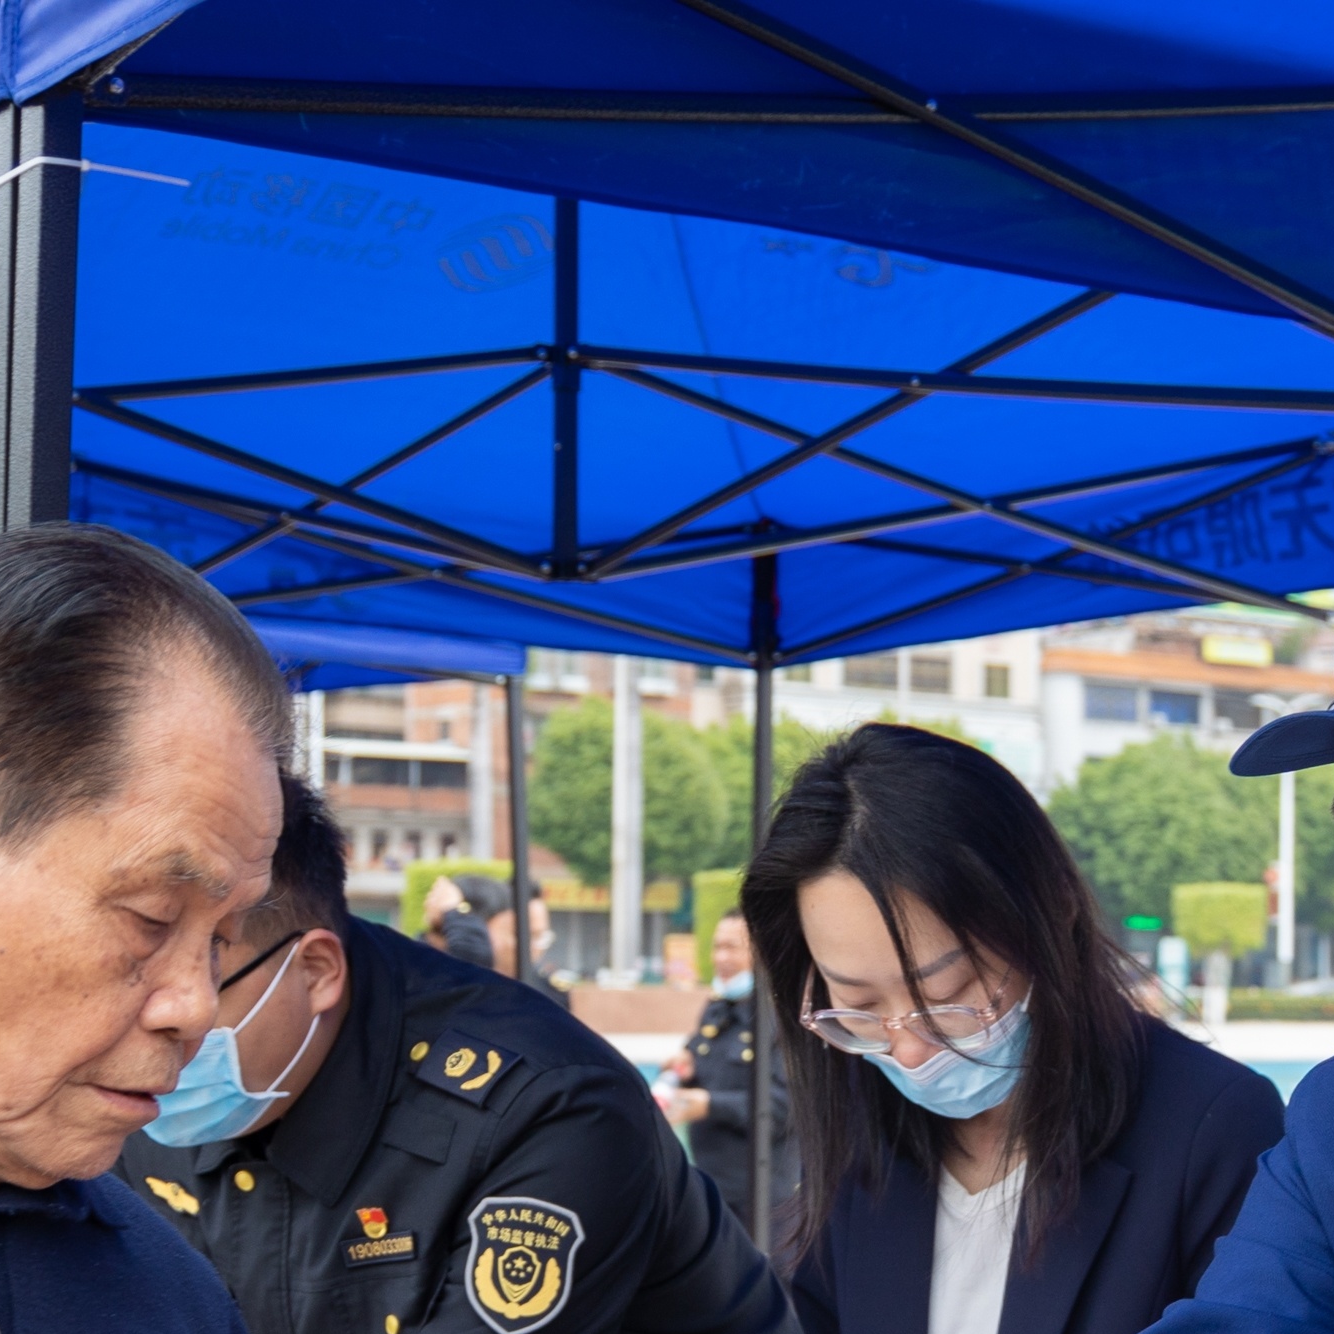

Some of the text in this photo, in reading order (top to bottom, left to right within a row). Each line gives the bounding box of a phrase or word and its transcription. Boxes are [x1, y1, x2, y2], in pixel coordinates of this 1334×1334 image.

[481, 1208, 571, 1238] 中华人民共和国
[486, 1226, 561, 1250] 市场监管执法
